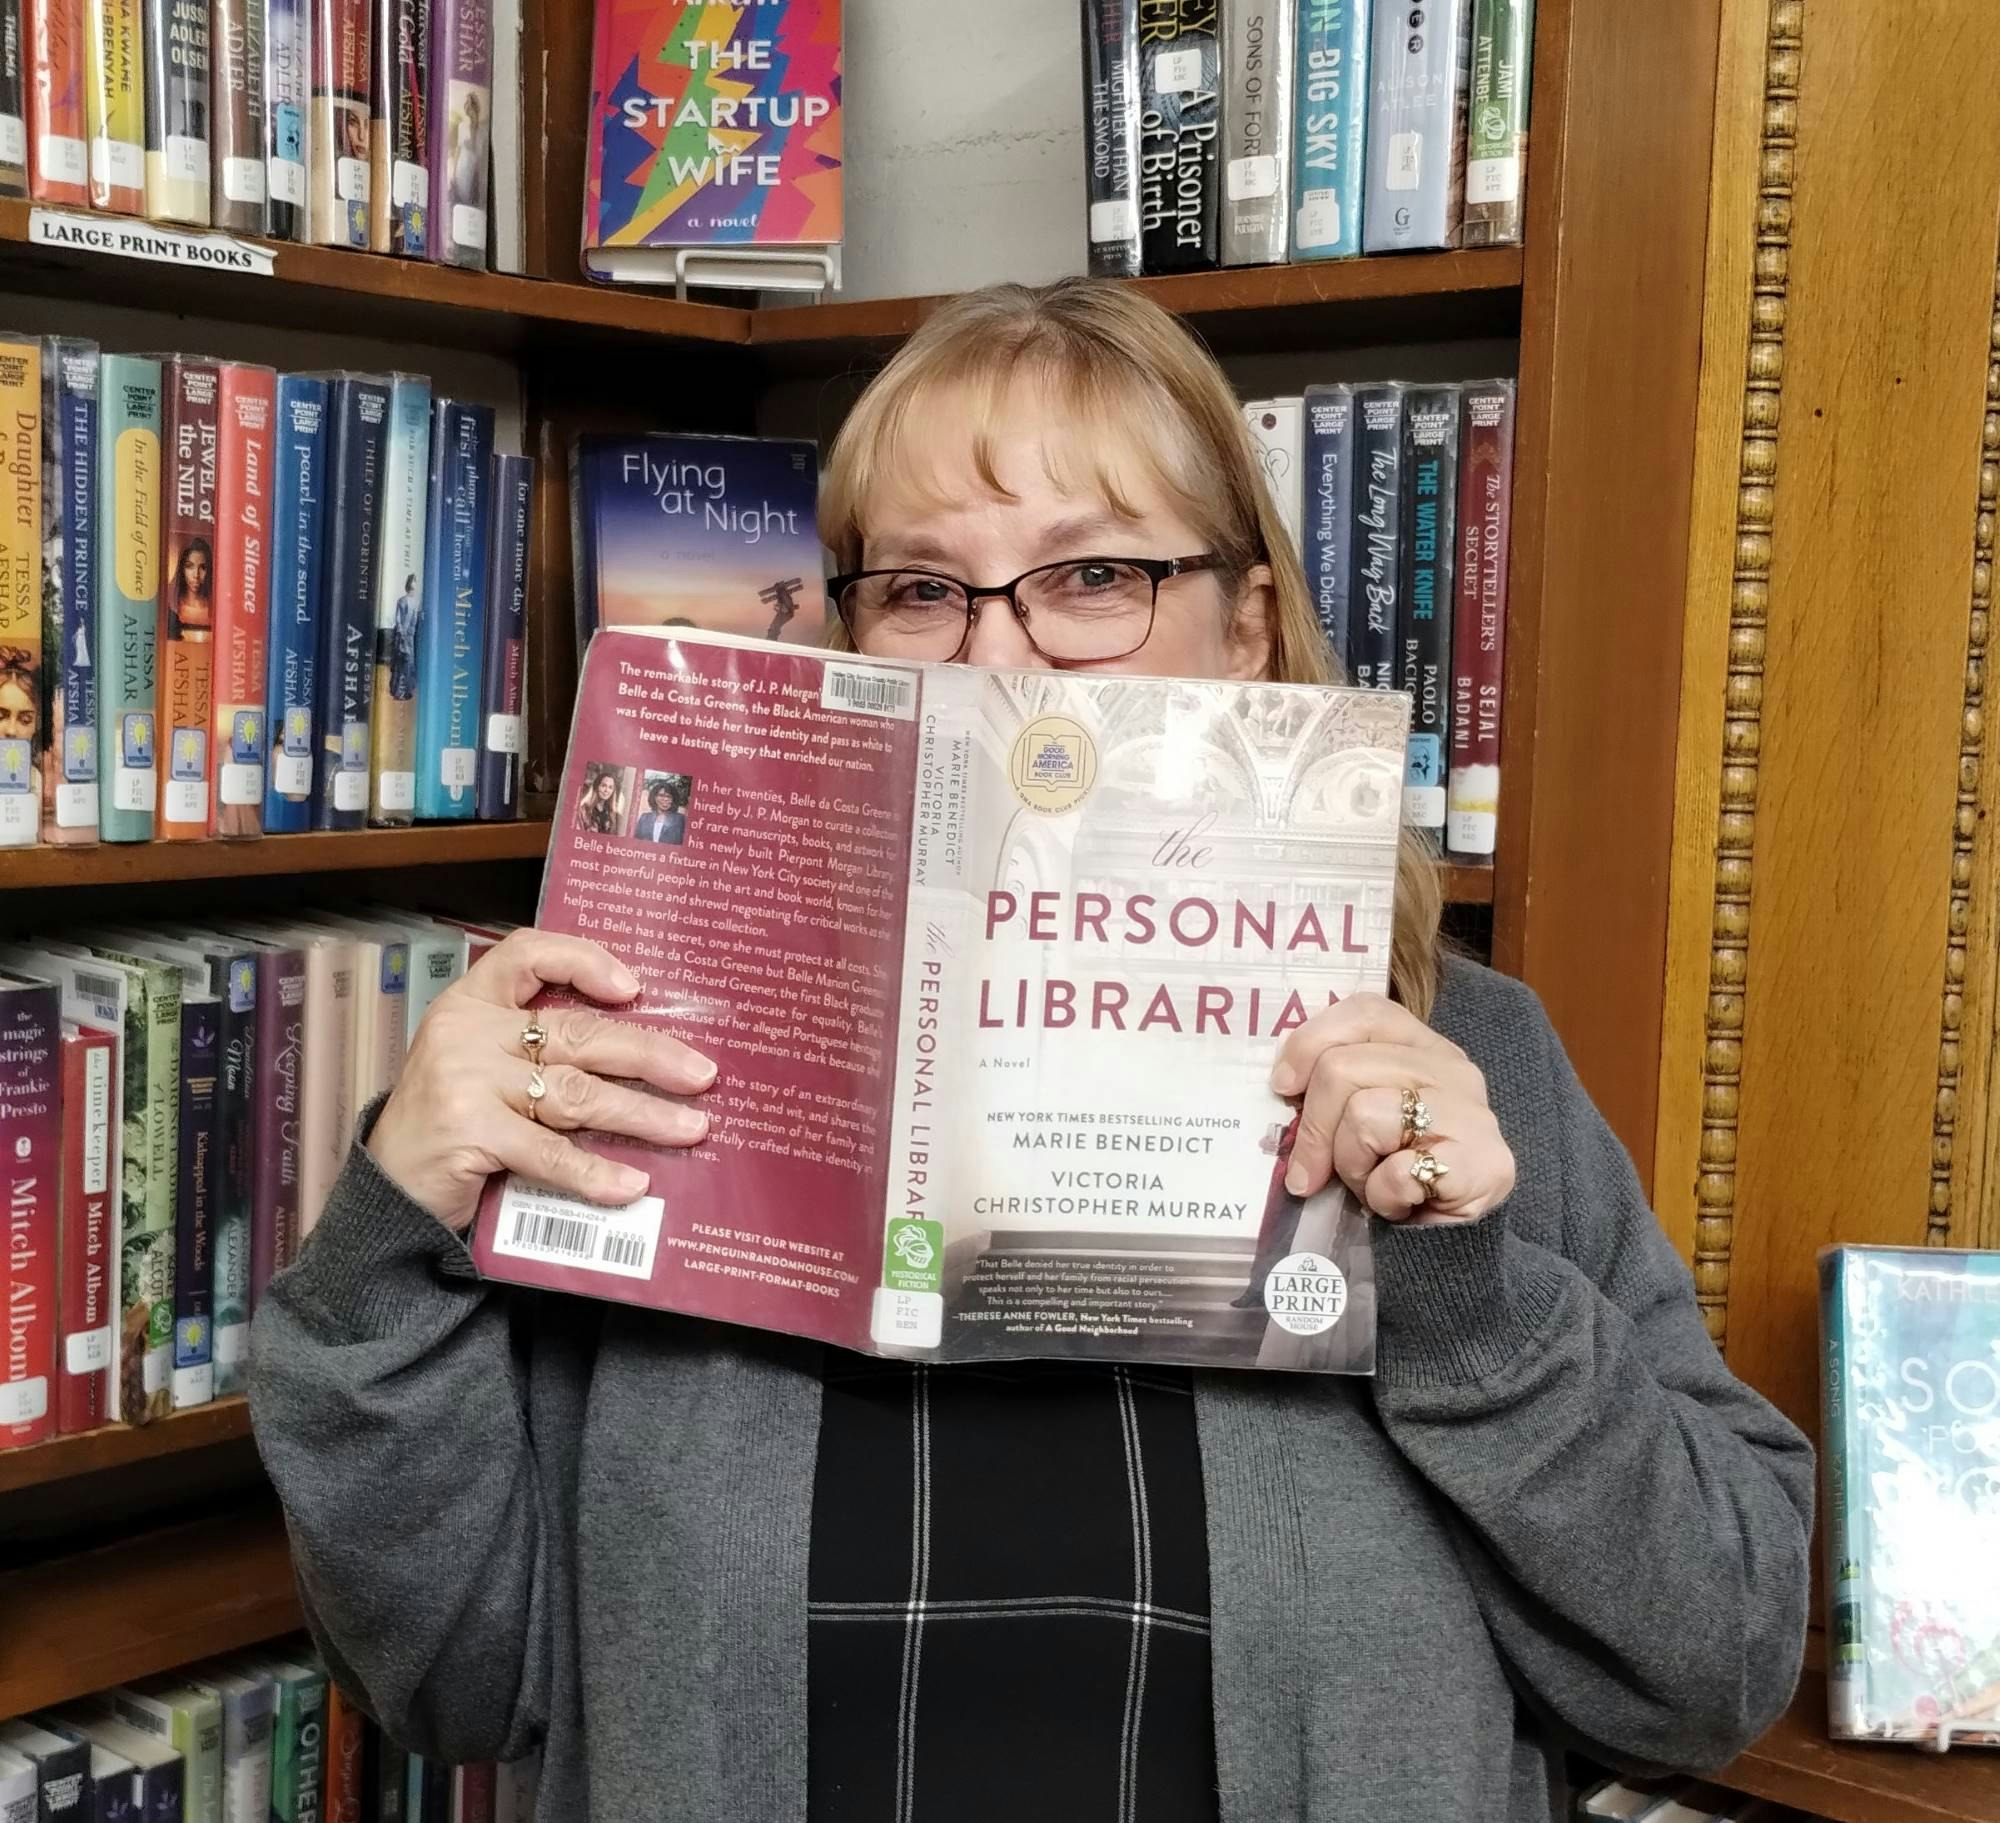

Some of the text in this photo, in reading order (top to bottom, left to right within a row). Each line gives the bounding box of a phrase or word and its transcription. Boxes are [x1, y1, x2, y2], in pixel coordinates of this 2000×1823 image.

[4, 15, 17, 77] THELMA
[120, 26, 132, 93] KWAME
[229, 21, 245, 91] ADLER
[399, 15, 415, 64] Gold
[684, 40, 772, 70] THE
[1246, 16, 1263, 104] SONS OF
[275, 41, 292, 104] ADLER
[1497, 59, 1514, 99] JAMI
[622, 96, 830, 129] STARTUP
[1093, 80, 1109, 178] THE SWORD
[1142, 110, 1179, 146] of
[1305, 48, 1341, 170] BIG SKY
[667, 156, 782, 187] WIFE
[1112, 140, 1128, 192] THAN
[1142, 149, 1177, 231] Birth
[1176, 90, 1217, 249] A Prisoner
[43, 222, 252, 268] LARGE PRINT BOOKS
[687, 214, 759, 229] a novel
[1395, 207, 1410, 226] G
[461, 415, 476, 458] first
[1311, 405, 1347, 414] CENTER
[1313, 421, 1344, 429] LARGE
[10, 411, 41, 528] Daughter
[177, 424, 198, 517] the NILE
[199, 420, 216, 524] JEWEL of
[623, 451, 726, 499] Flying
[74, 403, 89, 611] THE HIDDEN PRINCE
[134, 457, 148, 595] the Field Grace
[241, 440, 261, 614] Land of Silence
[294, 444, 316, 624] pearl in the sand
[359, 439, 376, 600] THIEF CORINTH
[660, 490, 799, 544] at Night
[509, 481, 528, 615] for one more day
[1316, 453, 1338, 628] Everything We Didn't
[1358, 448, 1398, 635] The Long Way Back
[1412, 460, 1438, 620] THE WATER KNIFE
[1464, 525, 1479, 600] SECRET
[1480, 474, 1500, 651] The STORYTELLER'S
[15, 552, 30, 621] TESSA
[124, 614, 138, 701] AFSHAR
[144, 625, 155, 690] TESSA
[232, 626, 246, 704] AFSHAR
[450, 586, 473, 747] Mitch Albom
[619, 661, 756, 694] The remarkable story of
[195, 662, 209, 726] TESSA
[616, 706, 810, 745] was forced hide her true identity
[618, 682, 848, 726] Belle da Costa Greene, the Black American
[1422, 664, 1438, 724] PAOLO
[1455, 677, 1472, 749] BADANI
[1478, 685, 1496, 742] SEJAL
[640, 727, 827, 767] leave lasting legacy that enriched
[1032, 760, 1073, 769] AMERICA
[697, 779, 786, 806] In her twenties,
[915, 714, 937, 886] CHRISTOPHER MURRAY
[931, 765, 945, 836] VICTORIA
[945, 739, 962, 865] MARIE BENEDICT
[573, 837, 657, 862] Belle becomes
[1152, 810, 1220, 869] the
[712, 919, 768, 938] collection.
[986, 890, 1369, 954] PERSONAL
[912, 961, 942, 1112] PERSONAL
[979, 978, 1343, 1038] LIBRARIA
[979, 1057, 1031, 1070] A Novel
[0, 1103, 47, 1119] Presto
[152, 1097, 165, 1182] LOWELL
[987, 1112, 1241, 1129] NEW YORK TIMES BESTSELLING AUTHOR
[1013, 1132, 1213, 1154] MARIE BENEDICT
[973, 1197, 1247, 1221] CHRISTOPHER MURRAY
[1051, 1171, 1164, 1191] VICTORIA
[85, 1201, 103, 1324] Mitch Albom
[227, 1217, 240, 1298] ALEXANDER
[692, 1222, 831, 1259] PLEASE VISIT OUR WEBSITE
[9, 1178, 37, 1381] Mitch Albom
[1272, 1295, 1341, 1313] PRINT
[1273, 1276, 1342, 1294] LARGE
[1003, 1311, 1078, 1323] ANNE FOWLER,
[1829, 1354, 1843, 1418] SONG
